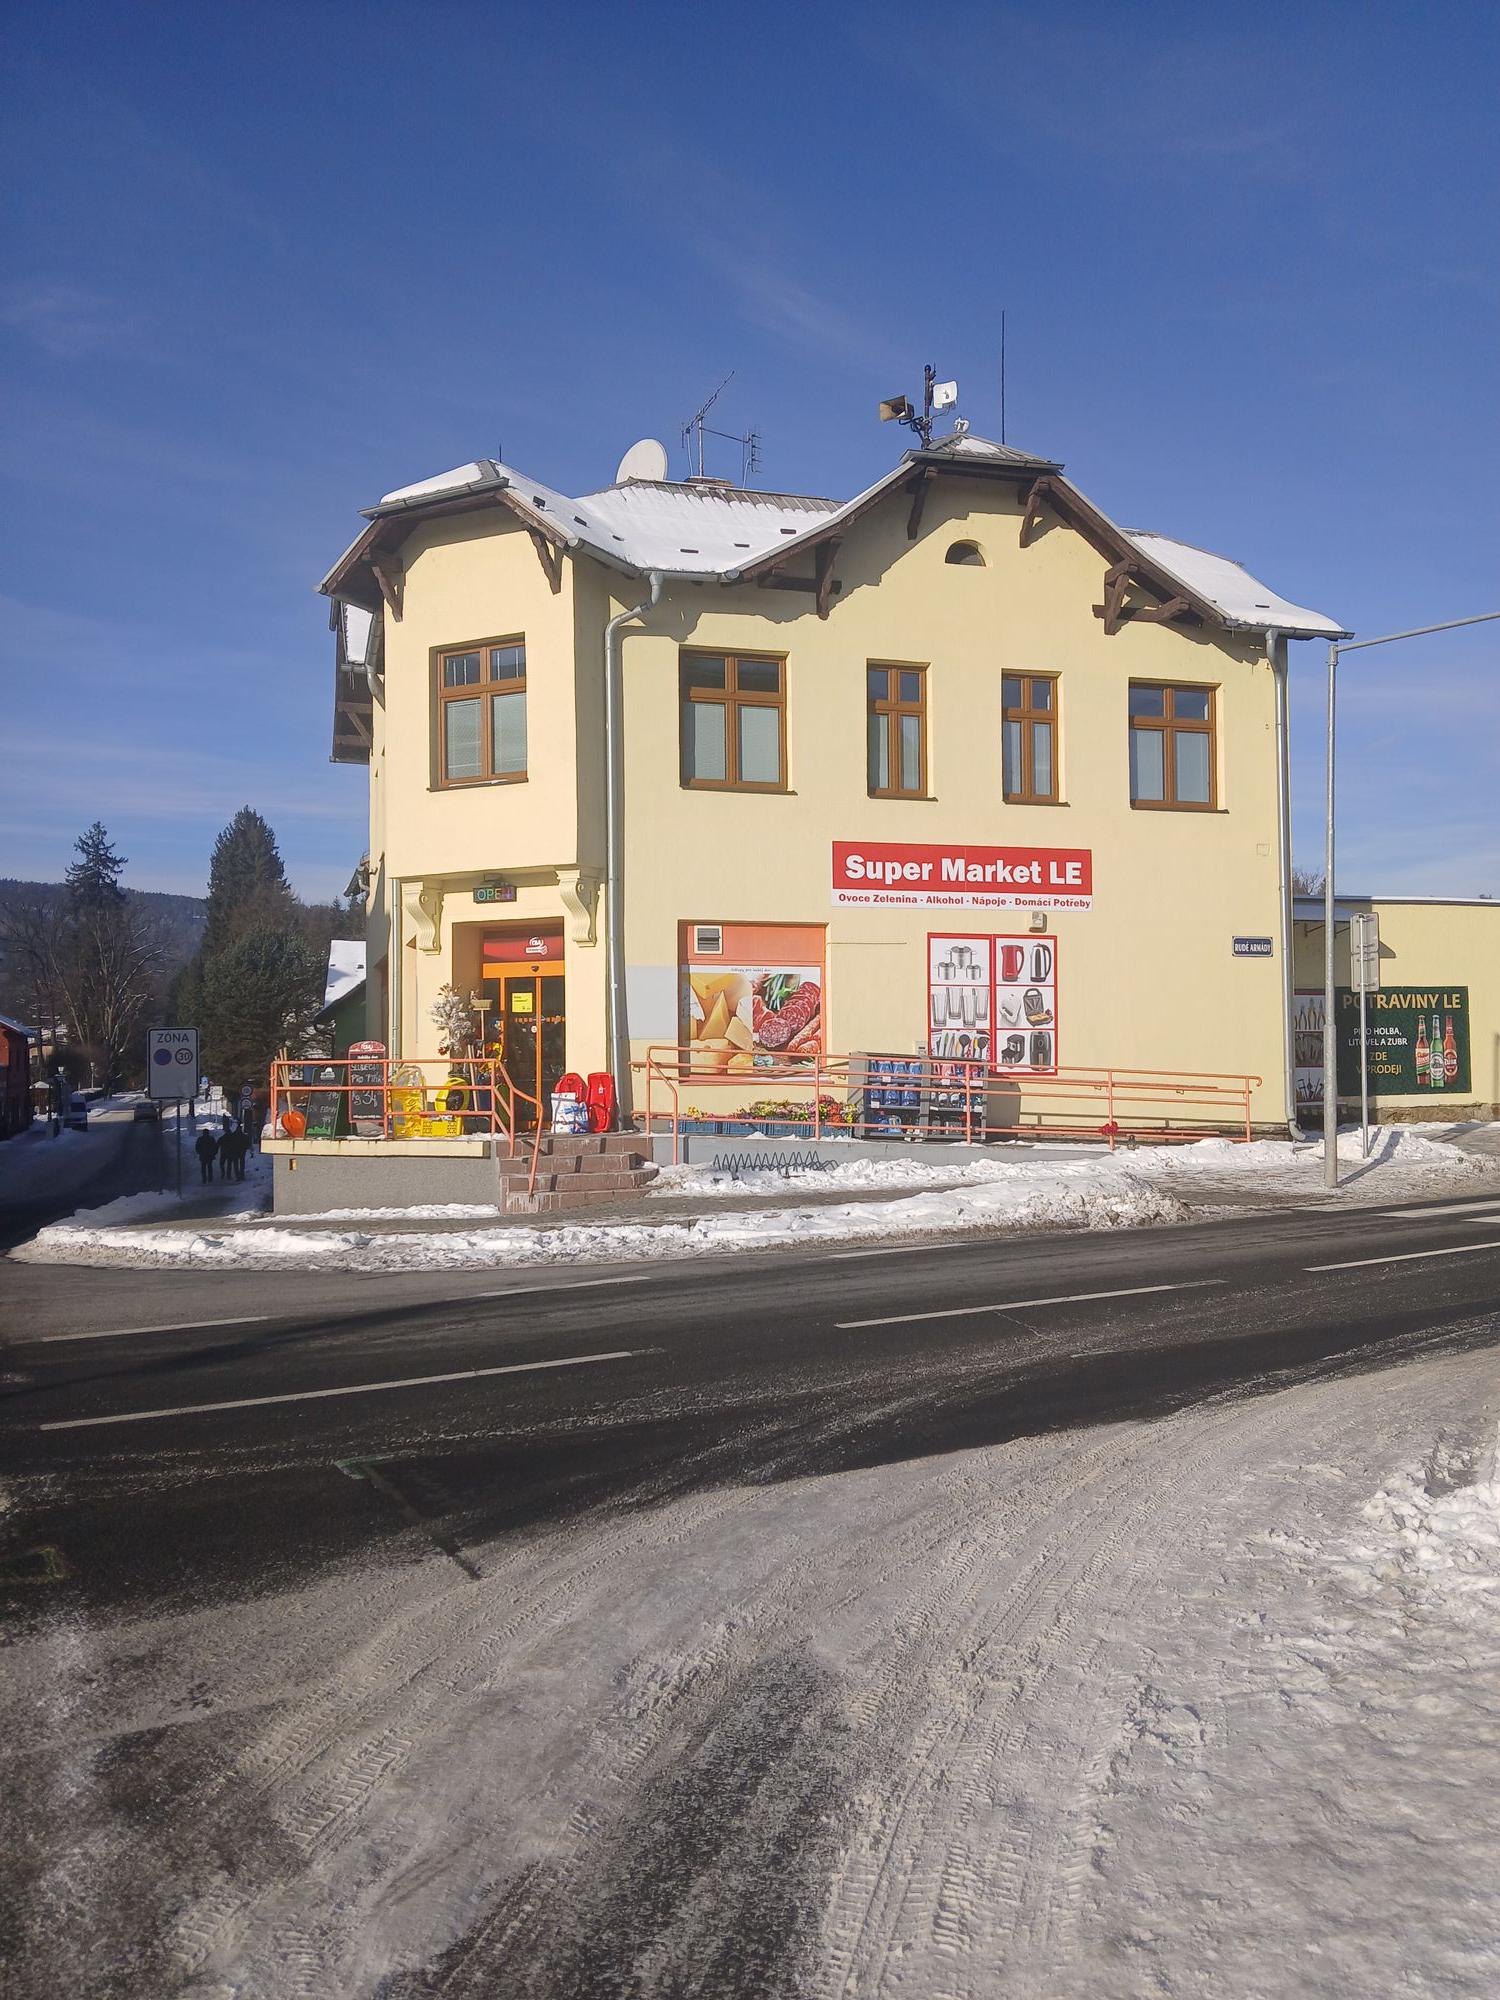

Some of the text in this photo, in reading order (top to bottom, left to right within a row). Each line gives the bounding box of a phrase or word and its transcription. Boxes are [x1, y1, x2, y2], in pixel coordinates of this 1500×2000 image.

[845, 854, 1082, 885] Super Market LE
[839, 893, 870, 903] Ovoce
[873, 894, 918, 904] Zelenina
[926, 895, 964, 905] Alkohol
[972, 896, 1007, 907] Nápoje
[1015, 897, 1051, 907] Domácí
[1054, 897, 1091, 909] Potřeby
[1235, 941, 1270, 952] RUDÉ ARMÁDY
[1444, 993, 1461, 1009] LE
[1353, 1027, 1402, 1037] PIO HOLBA,
[1380, 1038, 1387, 1046] A
[1387, 1038, 1408, 1046] ZUBR
[178, 1052, 190, 1061] 30
[1370, 1051, 1388, 1061] ZDE
